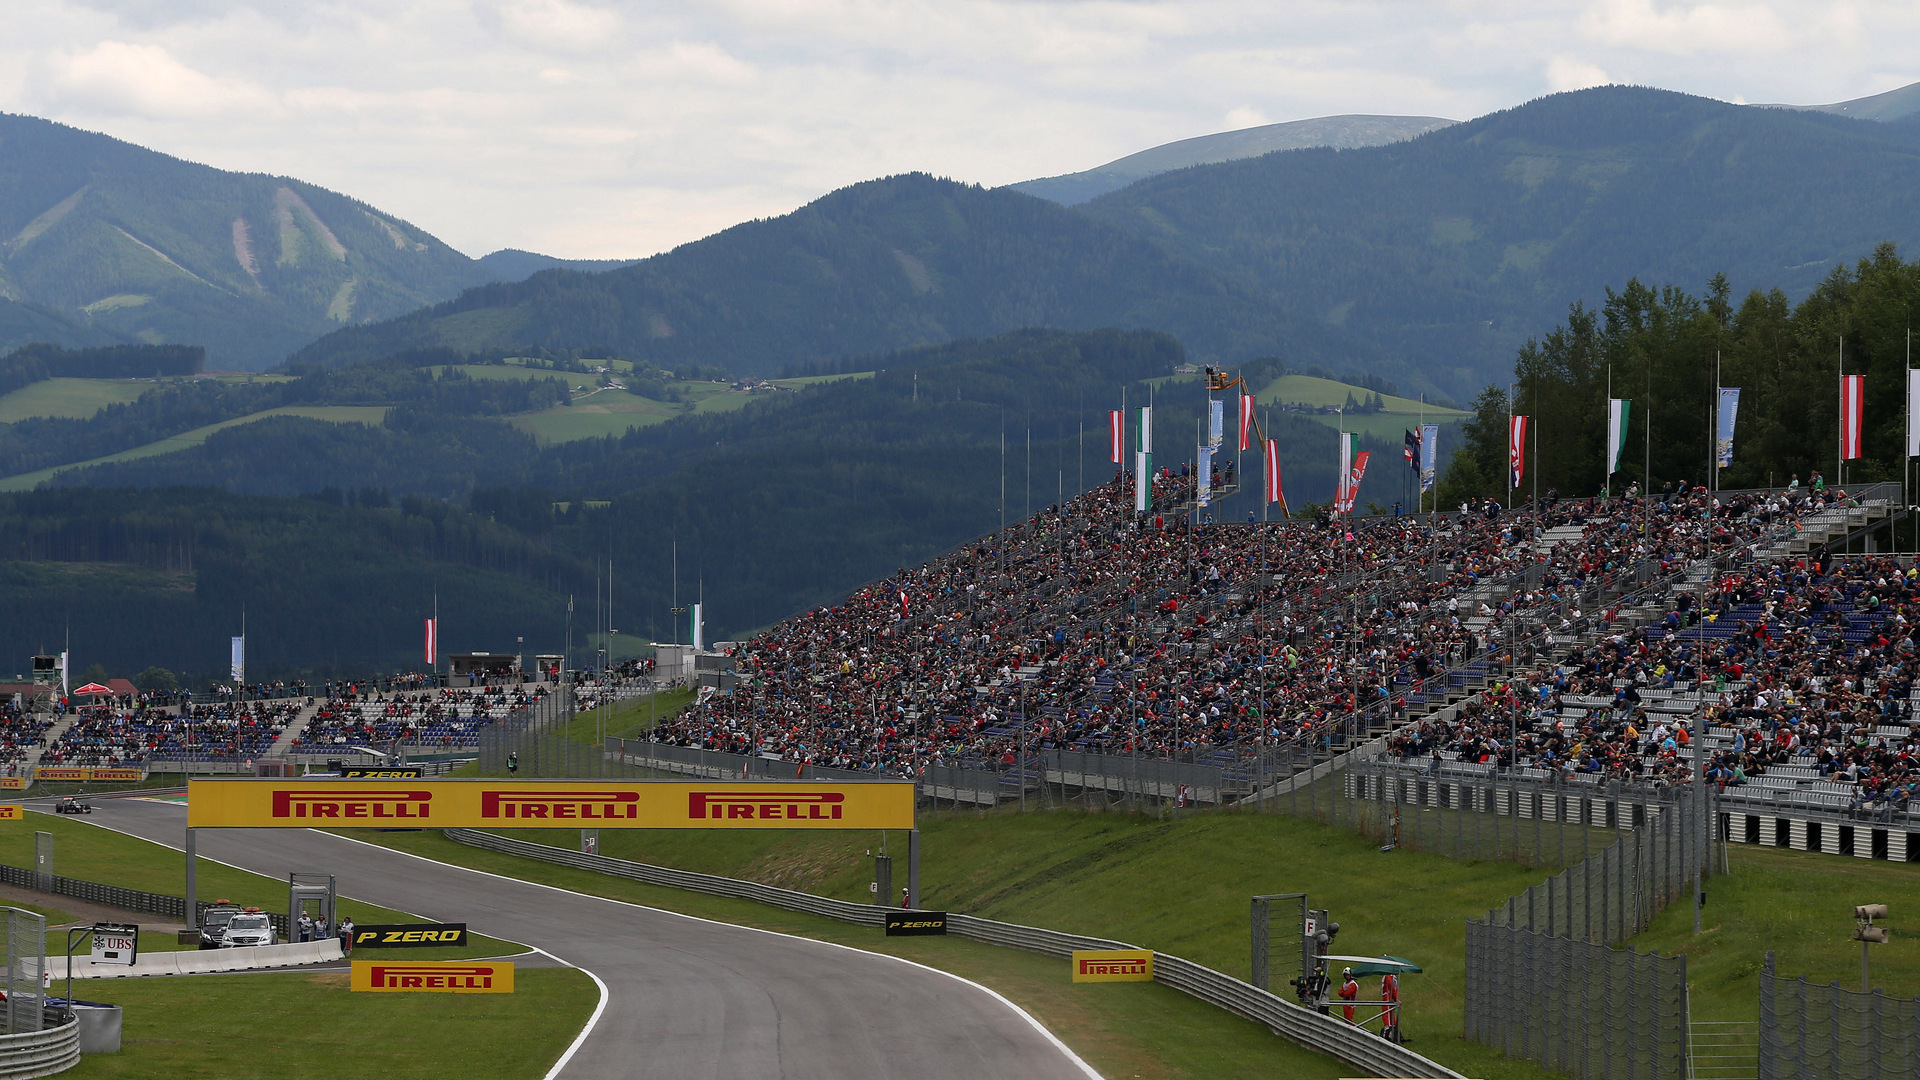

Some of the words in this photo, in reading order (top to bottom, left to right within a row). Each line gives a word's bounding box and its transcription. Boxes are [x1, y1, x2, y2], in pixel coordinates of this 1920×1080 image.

[273, 791, 432, 817] PIRELLI
[482, 792, 639, 818] PIRELLI
[689, 793, 844, 819] PIRELLI
[902, 921, 943, 929] ZERO
[1308, 922, 1314, 933] F
[107, 938, 132, 949] UBS
[356, 931, 378, 943] P
[383, 929, 461, 943] ZERO
[1080, 959, 1146, 974] PIRELLI
[371, 967, 493, 988] PIRELLI
